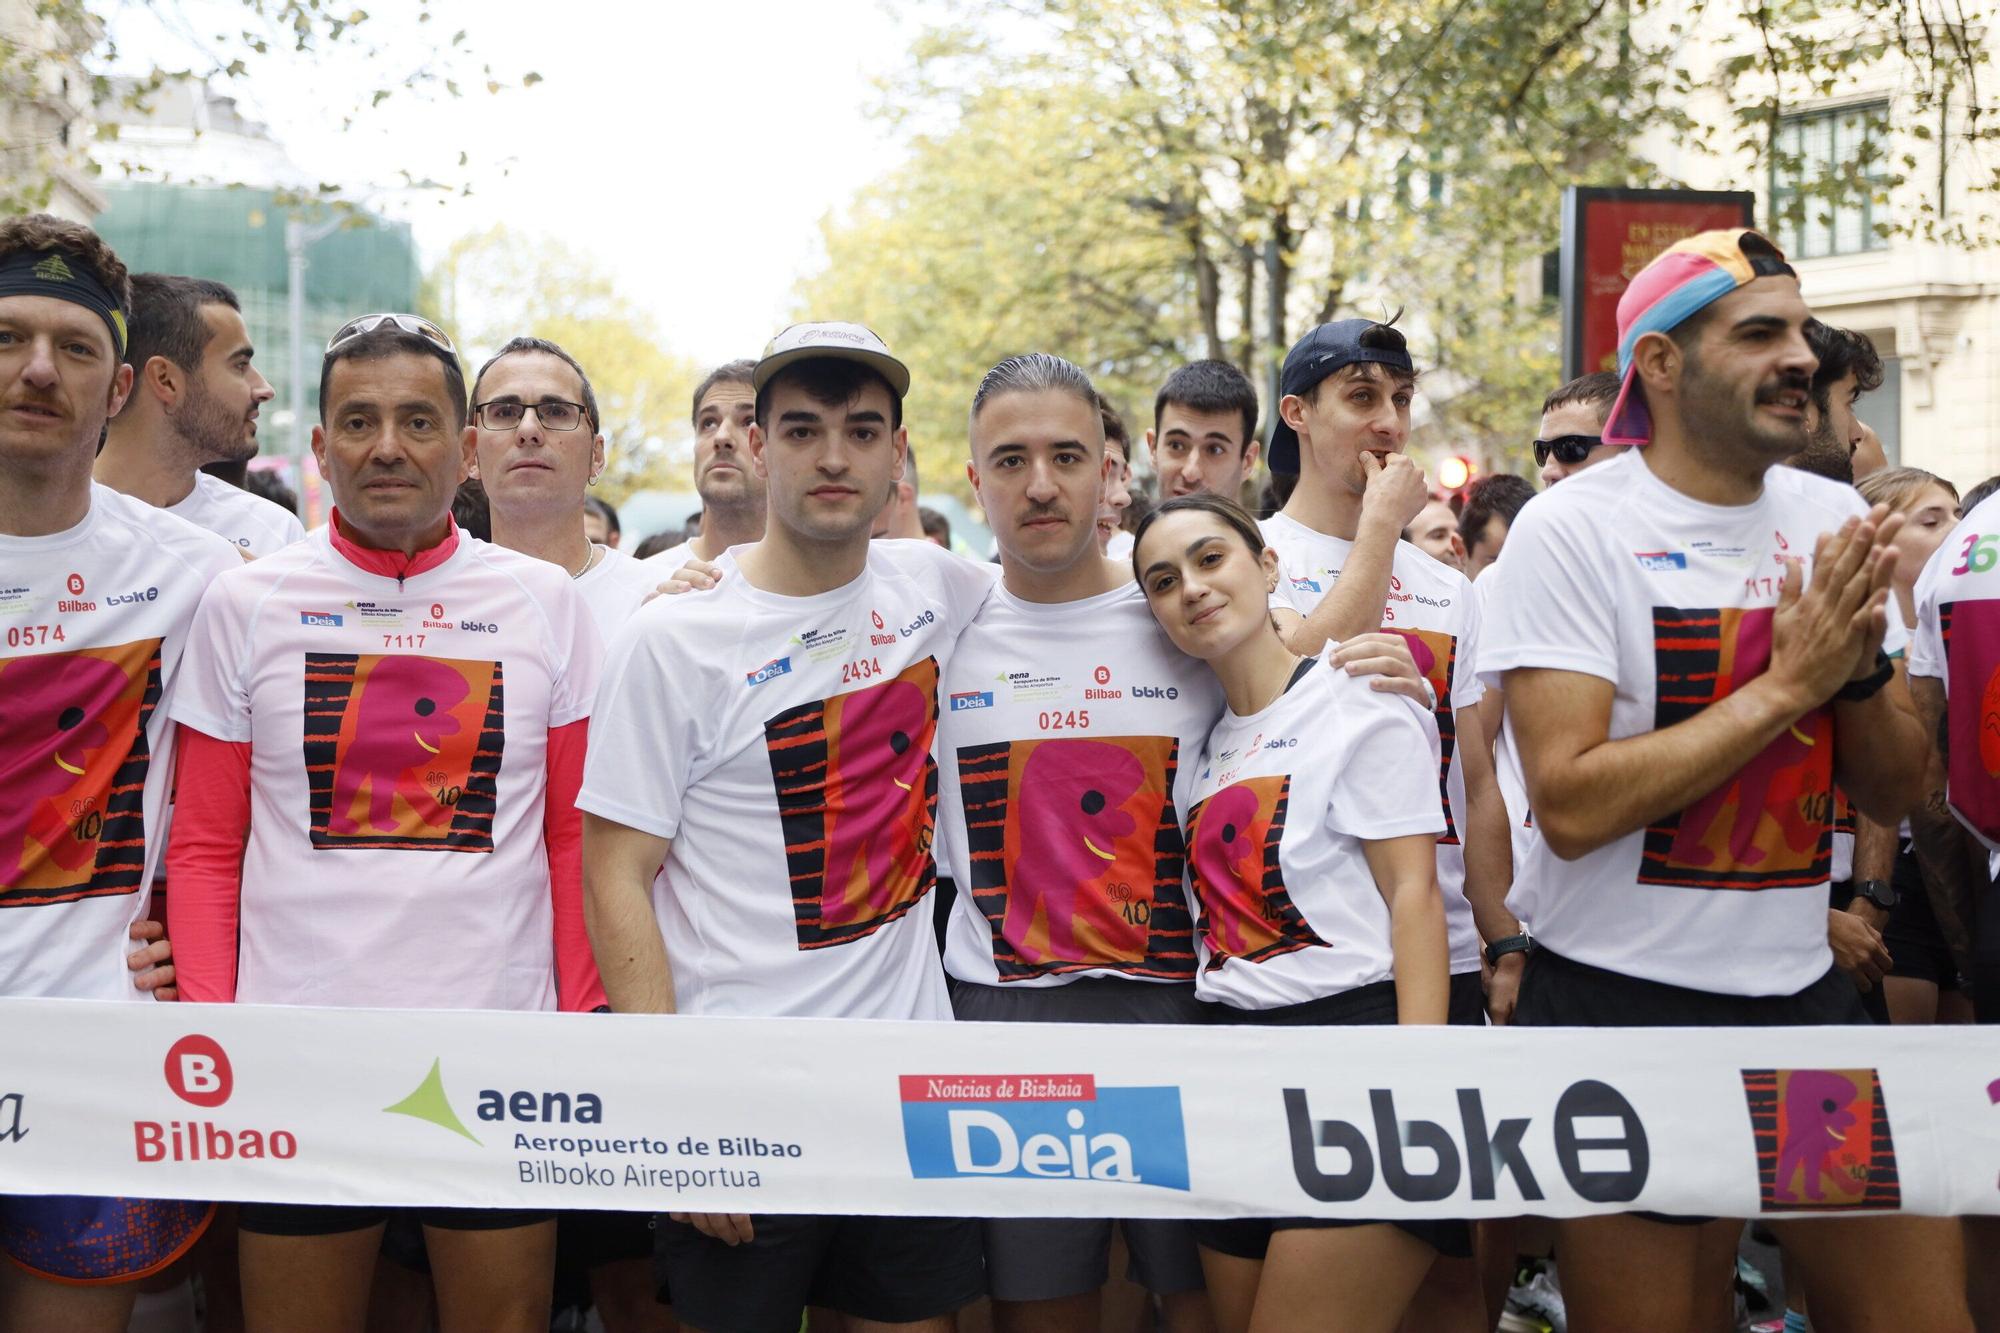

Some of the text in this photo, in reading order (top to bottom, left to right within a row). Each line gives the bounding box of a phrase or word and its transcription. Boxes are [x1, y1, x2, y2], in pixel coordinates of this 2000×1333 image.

[58, 600, 96, 613] Bilbao
[106, 590, 146, 606] bbk
[308, 616, 336, 626] Deia
[423, 620, 453, 630] Bilbao
[461, 620, 487, 632] bbk
[7, 624, 66, 647] 0574
[383, 634, 426, 648] 7117
[870, 634, 896, 646] Bilbao
[842, 657, 882, 683] 2434
[1009, 672, 1030, 680] aena
[958, 696, 986, 710] Deia
[1085, 688, 1122, 700] Bilbao
[1132, 686, 1165, 700] bbk
[1039, 710, 1090, 730] 0245
[437, 786, 462, 806] 10
[1123, 899, 1150, 925] 10
[180, 1054, 221, 1094] B
[927, 1078, 1082, 1098] Noticias de Bizkaia
[476, 1088, 604, 1124] aena
[134, 1120, 298, 1162] Bilbao
[514, 1133, 802, 1158] Aeropuerto de Bilbao
[948, 1108, 1142, 1182] Deia
[1282, 1088, 1546, 1202] bbk
[518, 1160, 761, 1194] Bilboko Aireportua
